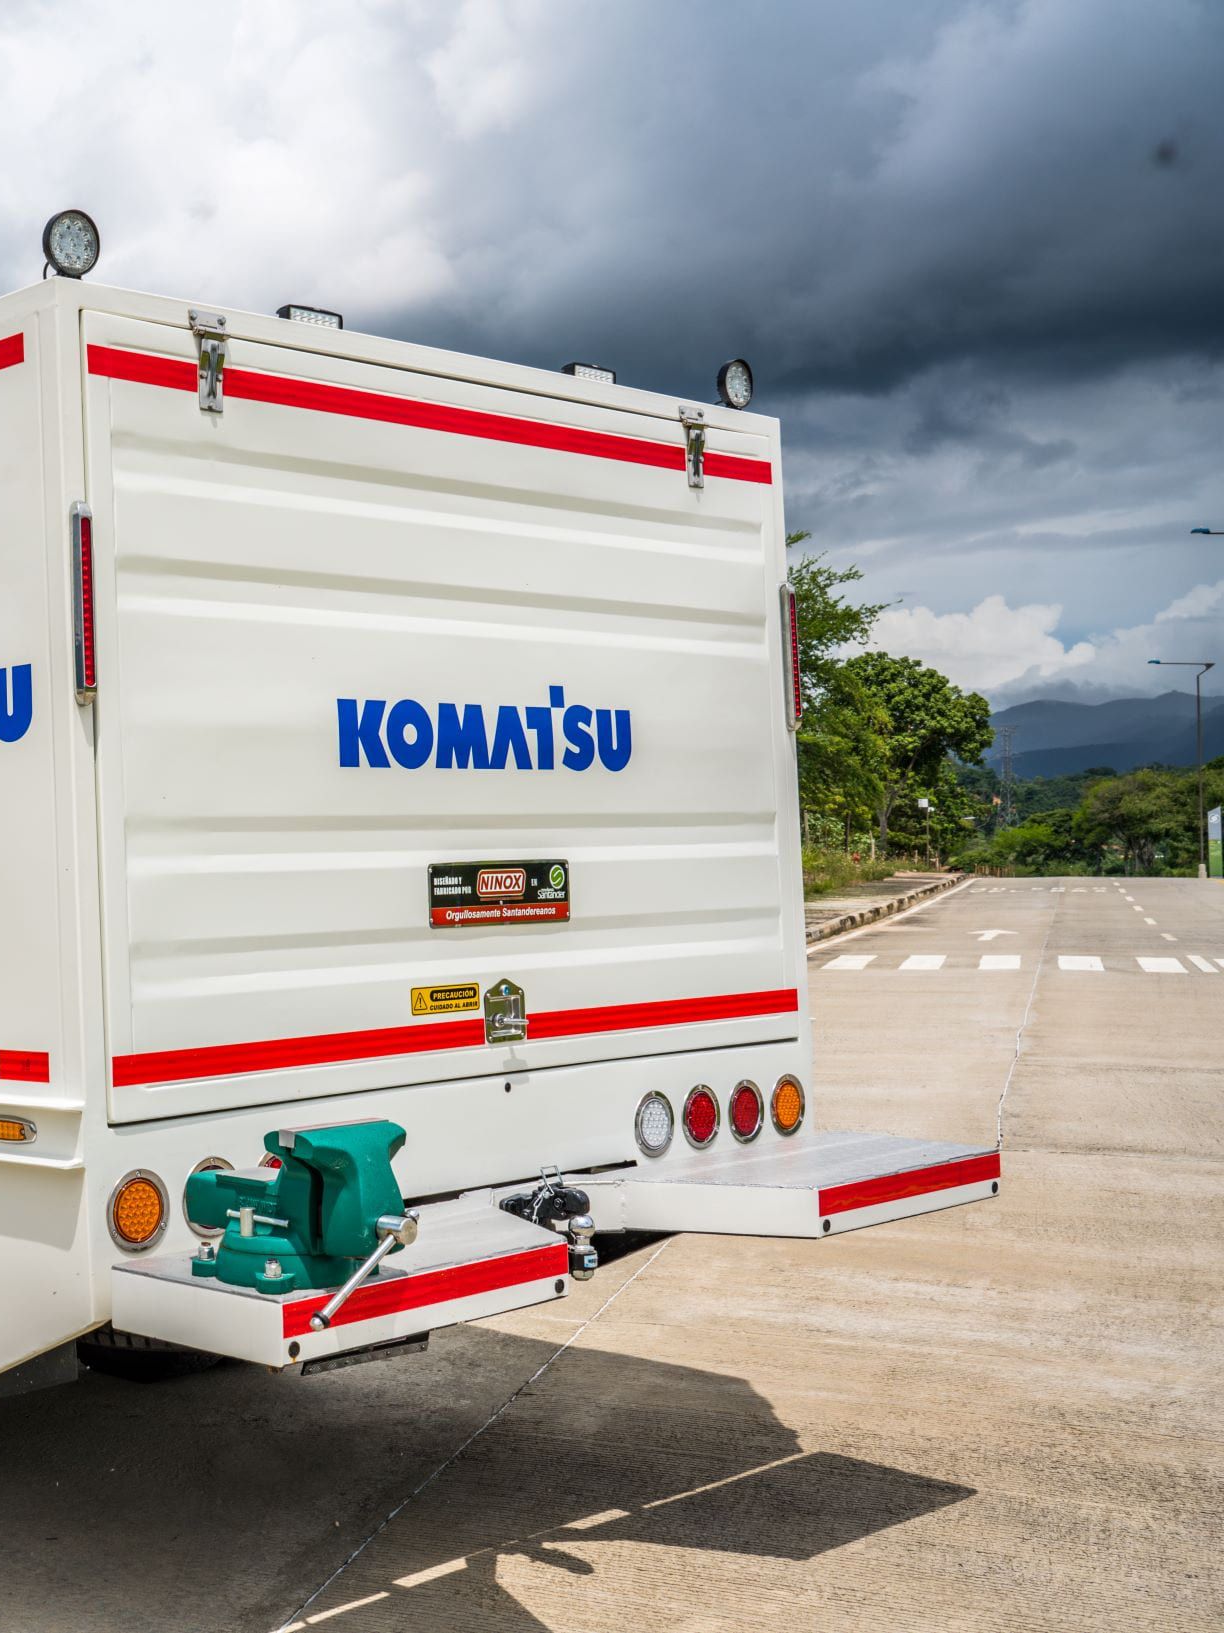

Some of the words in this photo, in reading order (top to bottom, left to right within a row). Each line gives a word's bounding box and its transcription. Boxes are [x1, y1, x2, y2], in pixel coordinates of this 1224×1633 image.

[336, 685, 632, 772] KOMATSU
[480, 874, 522, 891] NINOX
[537, 889, 566, 900] Santander
[446, 908, 501, 920] Orgullosamente
[502, 906, 556, 917] Santandereanos
[429, 1003, 454, 1011] CUIDADO
[462, 1000, 478, 1008] ABRIR
